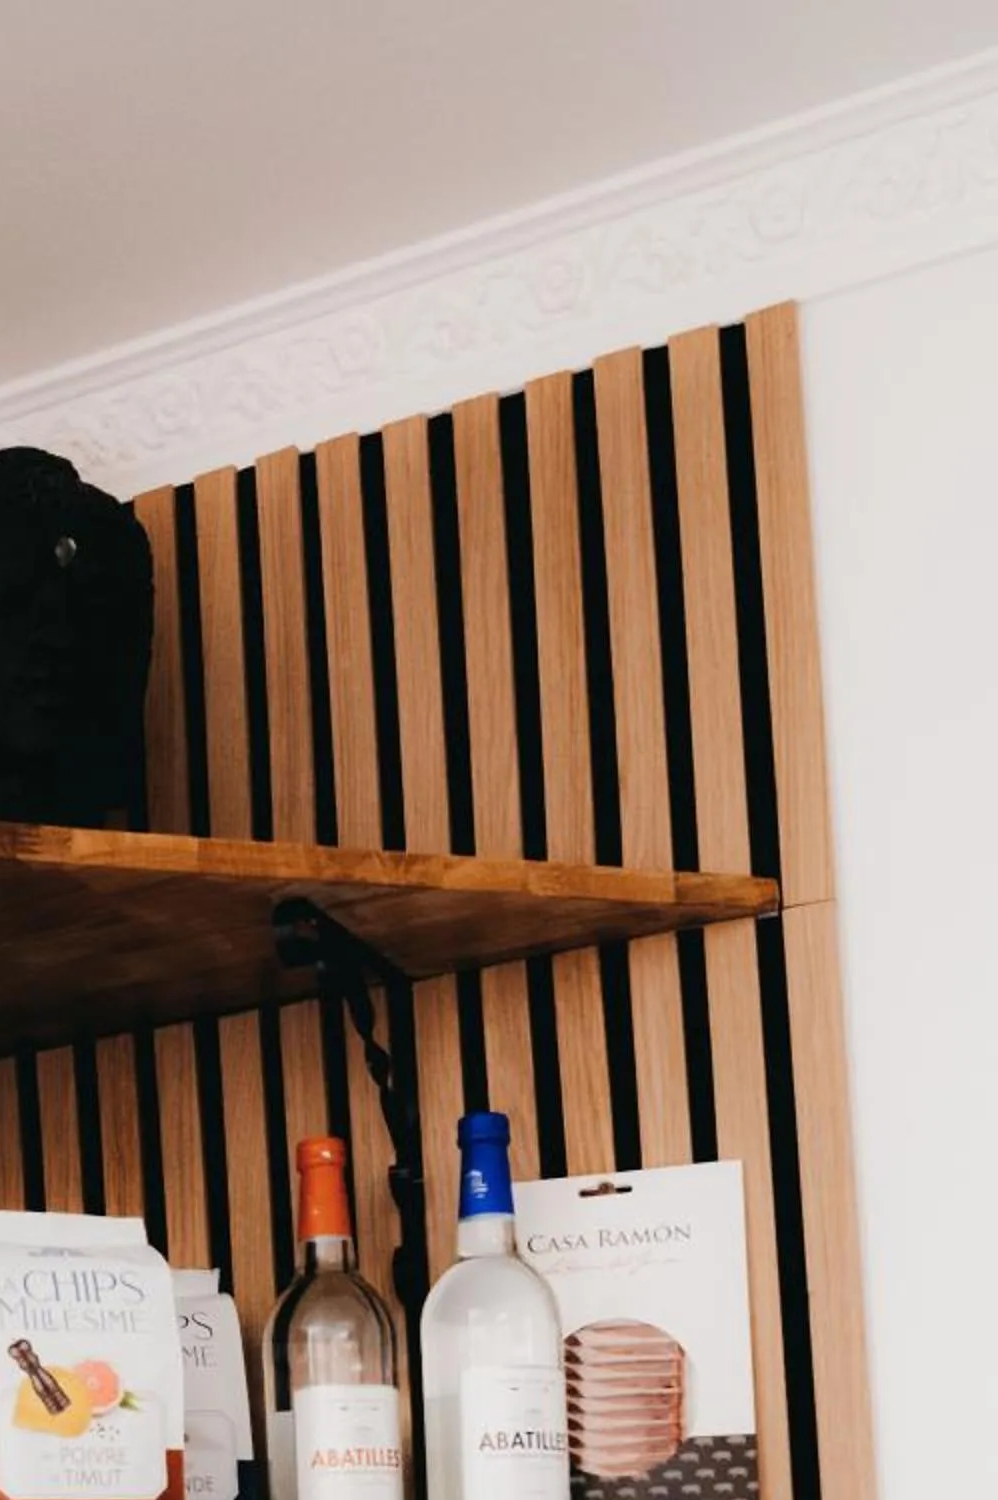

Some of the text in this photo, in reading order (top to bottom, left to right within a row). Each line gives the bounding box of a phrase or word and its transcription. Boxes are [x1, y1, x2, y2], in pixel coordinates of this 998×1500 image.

[527, 1234, 589, 1253] CASA
[23, 1270, 146, 1303] CHIPS
[479, 1431, 567, 1452] ABATILLE
[311, 1446, 400, 1469] ABATILLES
